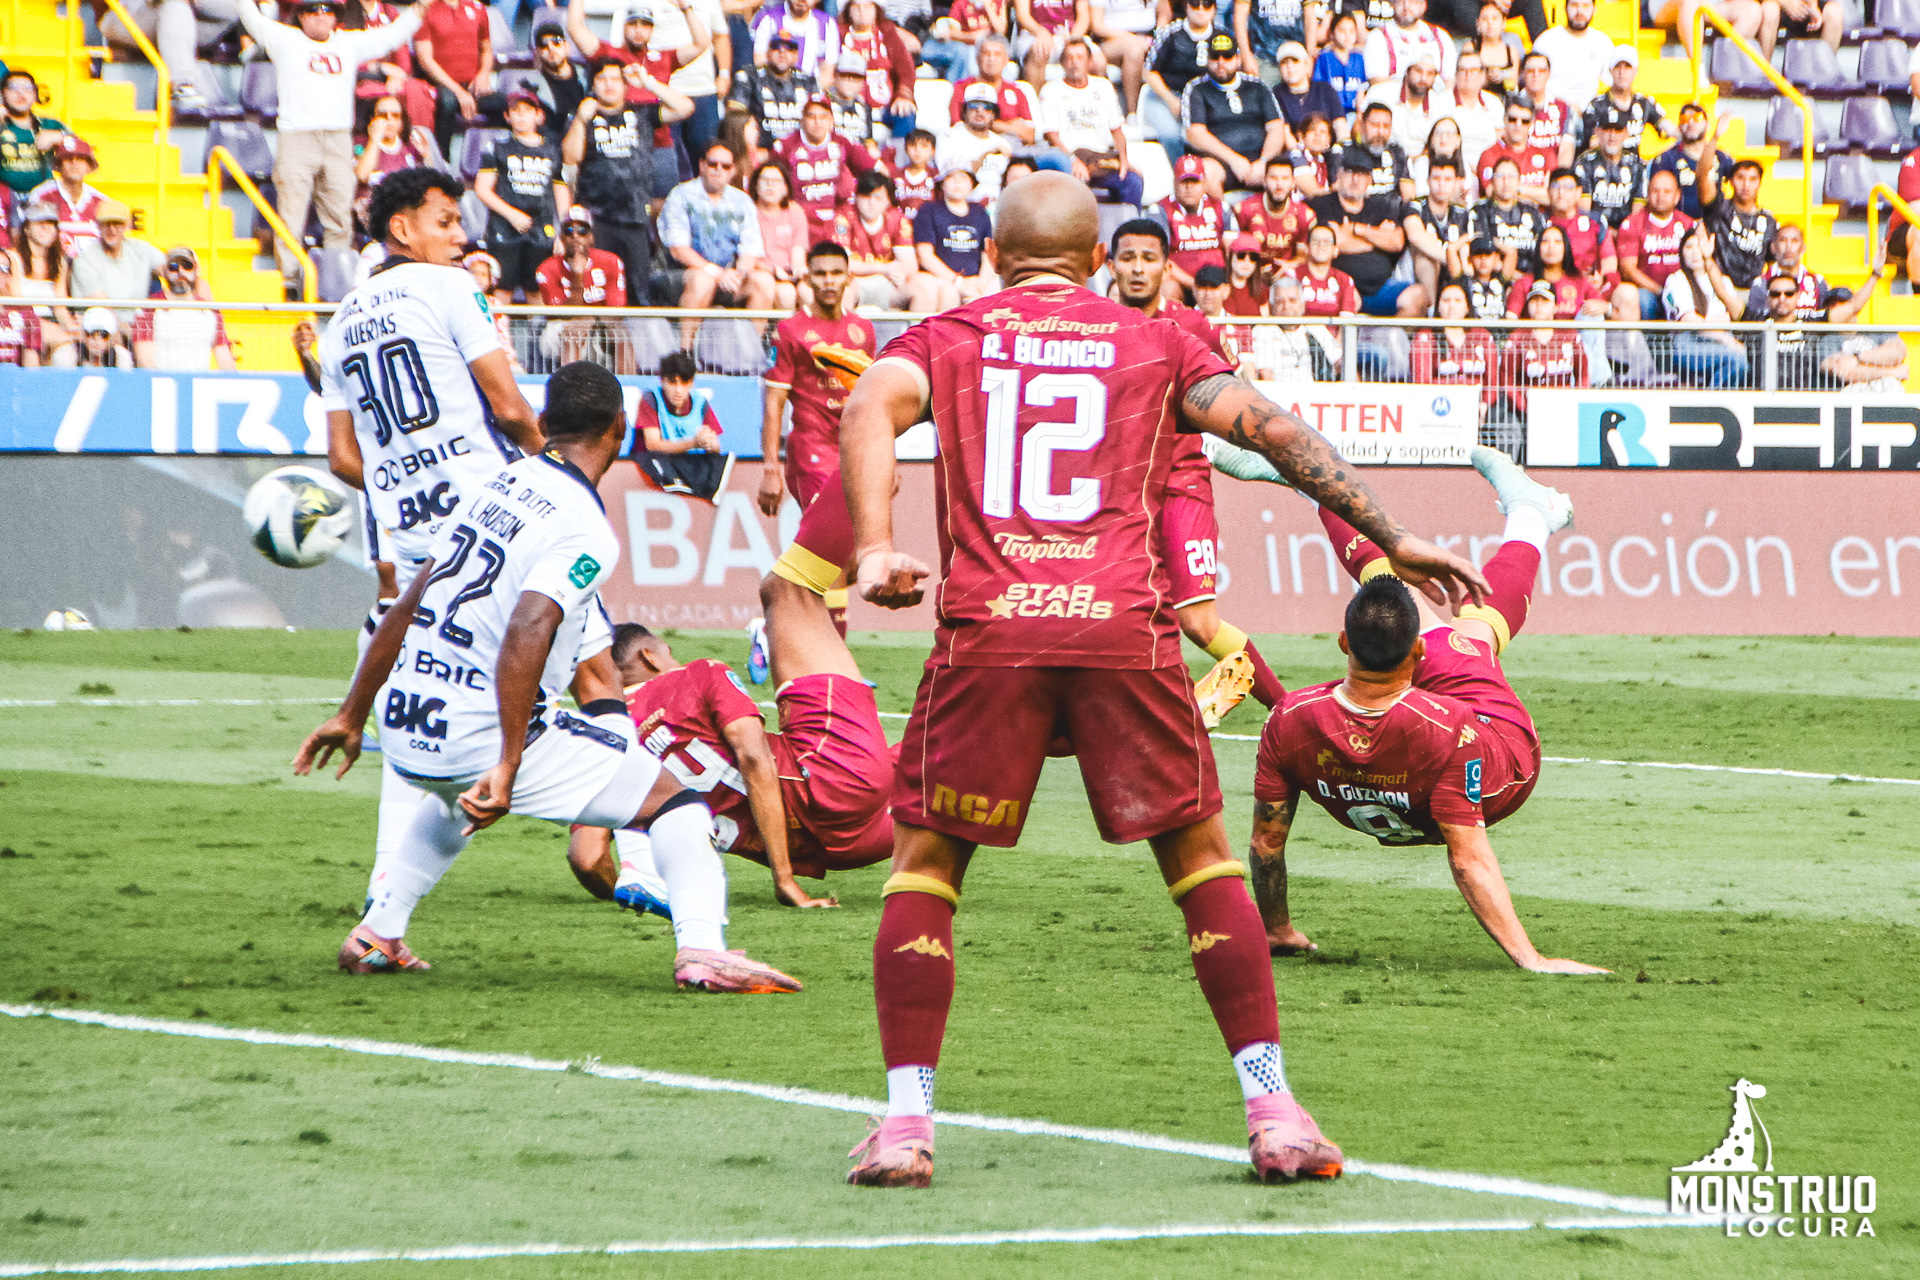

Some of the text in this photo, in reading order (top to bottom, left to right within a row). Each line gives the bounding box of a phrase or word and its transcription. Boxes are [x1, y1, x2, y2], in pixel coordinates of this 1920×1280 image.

[1004, 316, 1119, 336] medismart
[981, 333, 1116, 368] R. BLANCO
[341, 336, 440, 448] 30
[981, 366, 1108, 522] 12
[1399, 442, 1466, 460] soporte
[398, 481, 460, 530] BIG
[993, 532, 1099, 564] Tropical
[1185, 538, 1217, 576] 28
[412, 523, 506, 650] 22
[1005, 583, 1096, 602] STAR
[1017, 600, 1114, 619] CARS
[415, 650, 487, 692] BAIC
[384, 687, 448, 740] BIG
[409, 738, 441, 754] COLA
[931, 783, 1020, 827] RCA
[1316, 778, 1337, 799] D.
